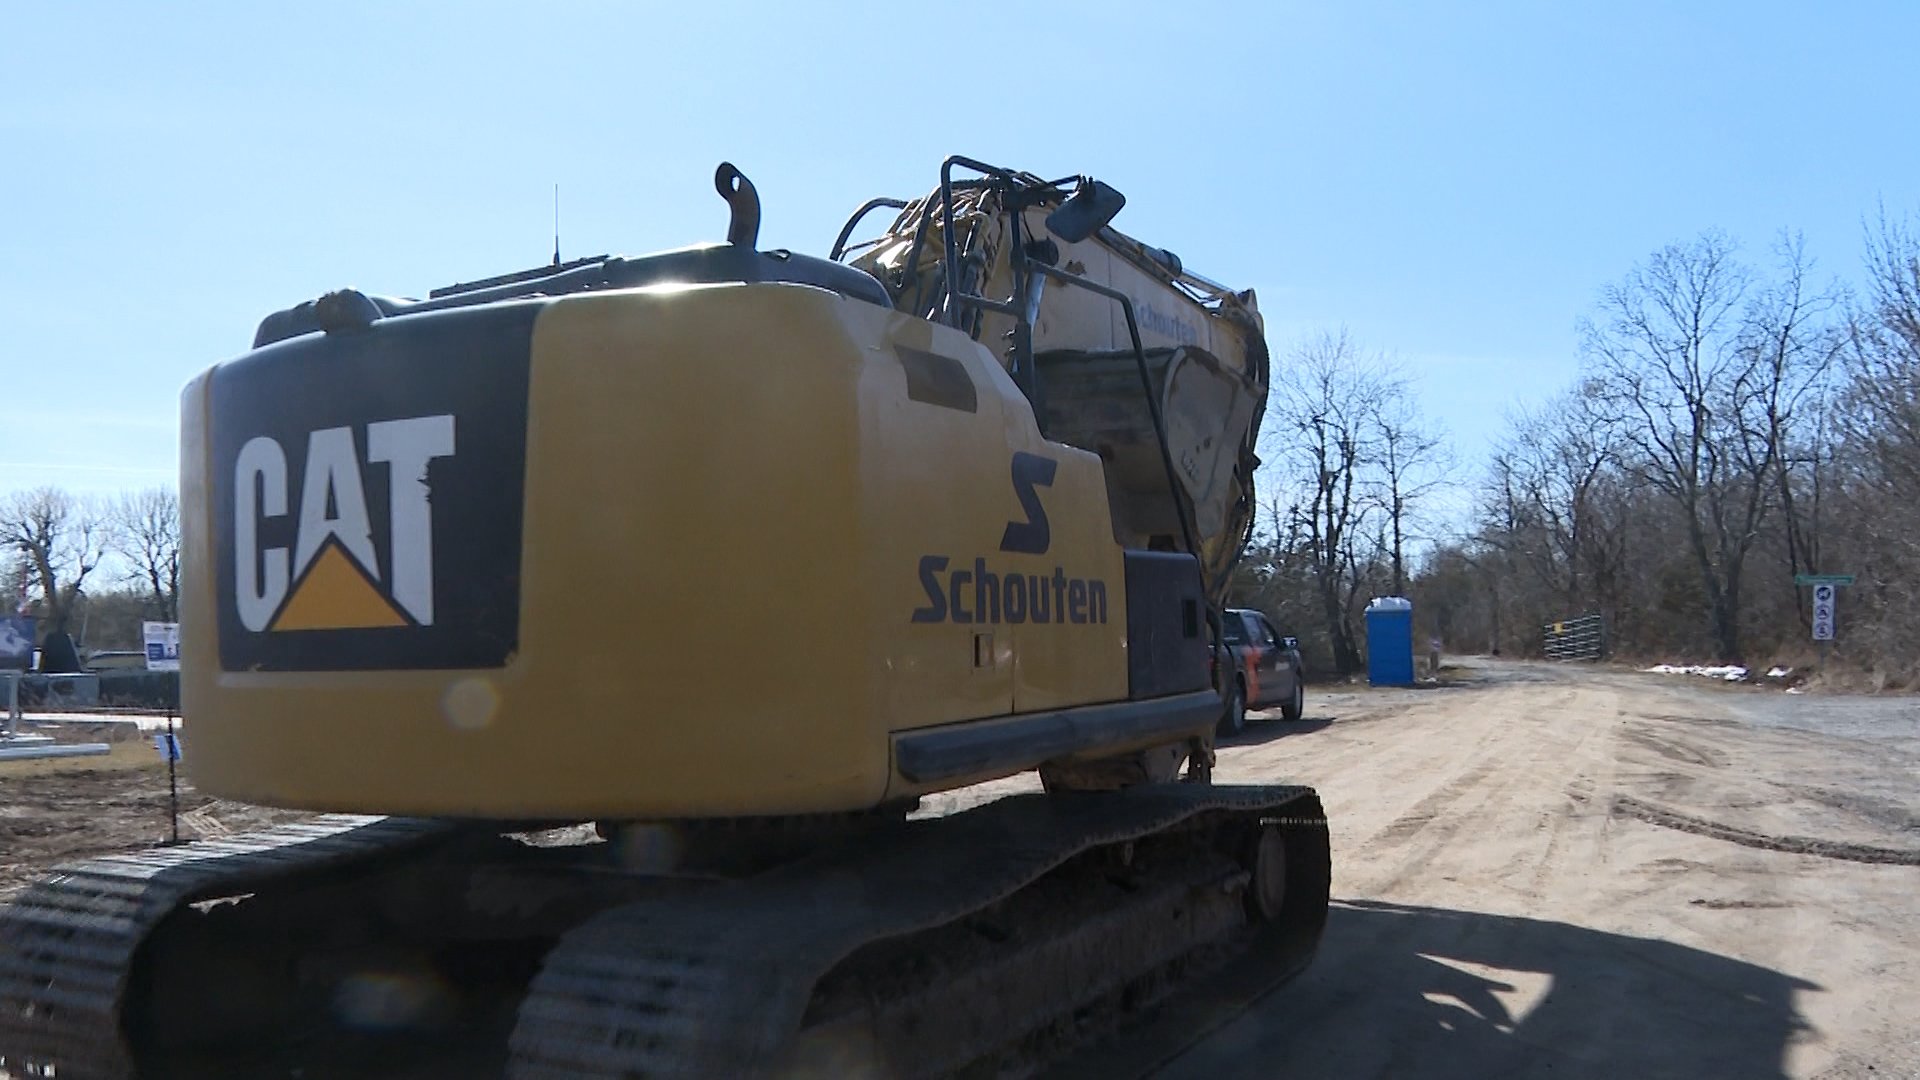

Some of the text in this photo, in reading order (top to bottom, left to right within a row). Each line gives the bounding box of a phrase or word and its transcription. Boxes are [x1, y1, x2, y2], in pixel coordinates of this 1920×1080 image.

[234, 414, 456, 633] CAT
[1000, 451, 1058, 555] S
[910, 555, 1107, 624] Schouten
